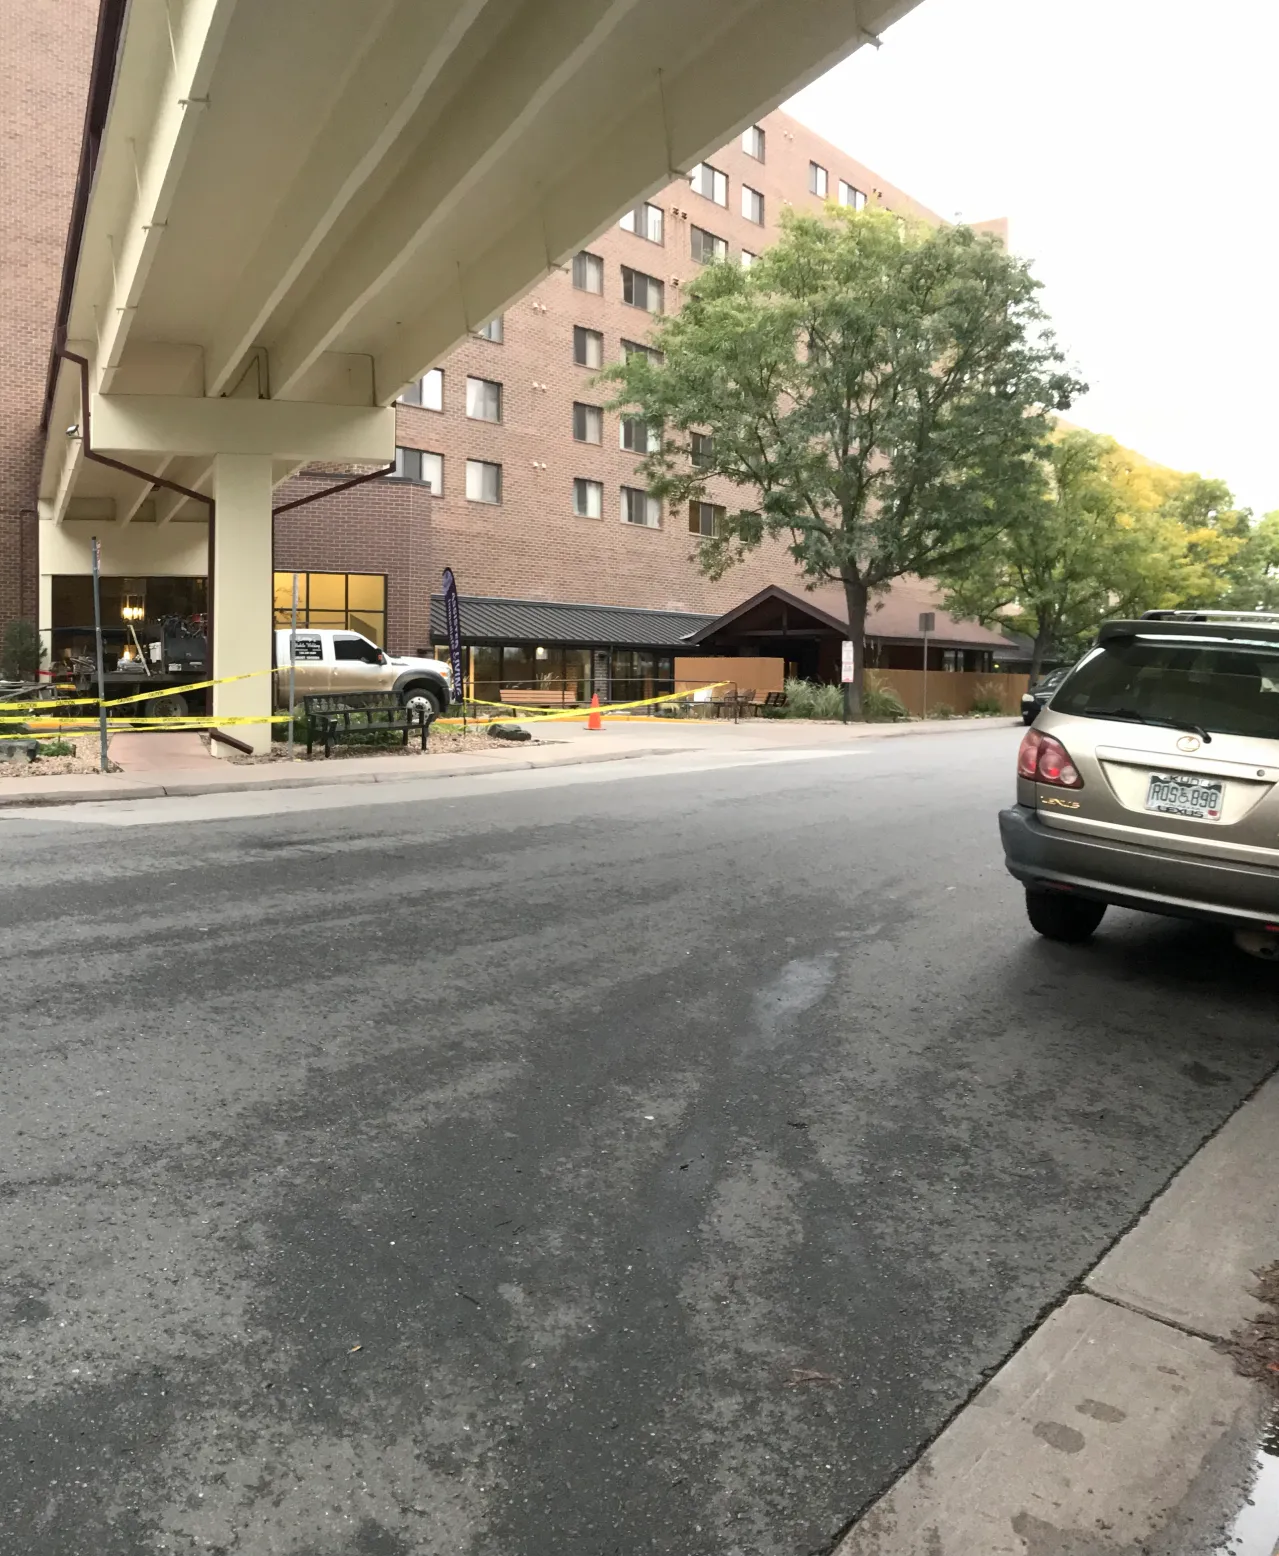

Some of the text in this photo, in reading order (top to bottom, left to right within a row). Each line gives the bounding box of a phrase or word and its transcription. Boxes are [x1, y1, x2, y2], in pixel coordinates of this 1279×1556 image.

[452, 651, 462, 696] LIVING
[1152, 784, 1218, 808] ROS 898
[1158, 805, 1204, 818] LEXUS
